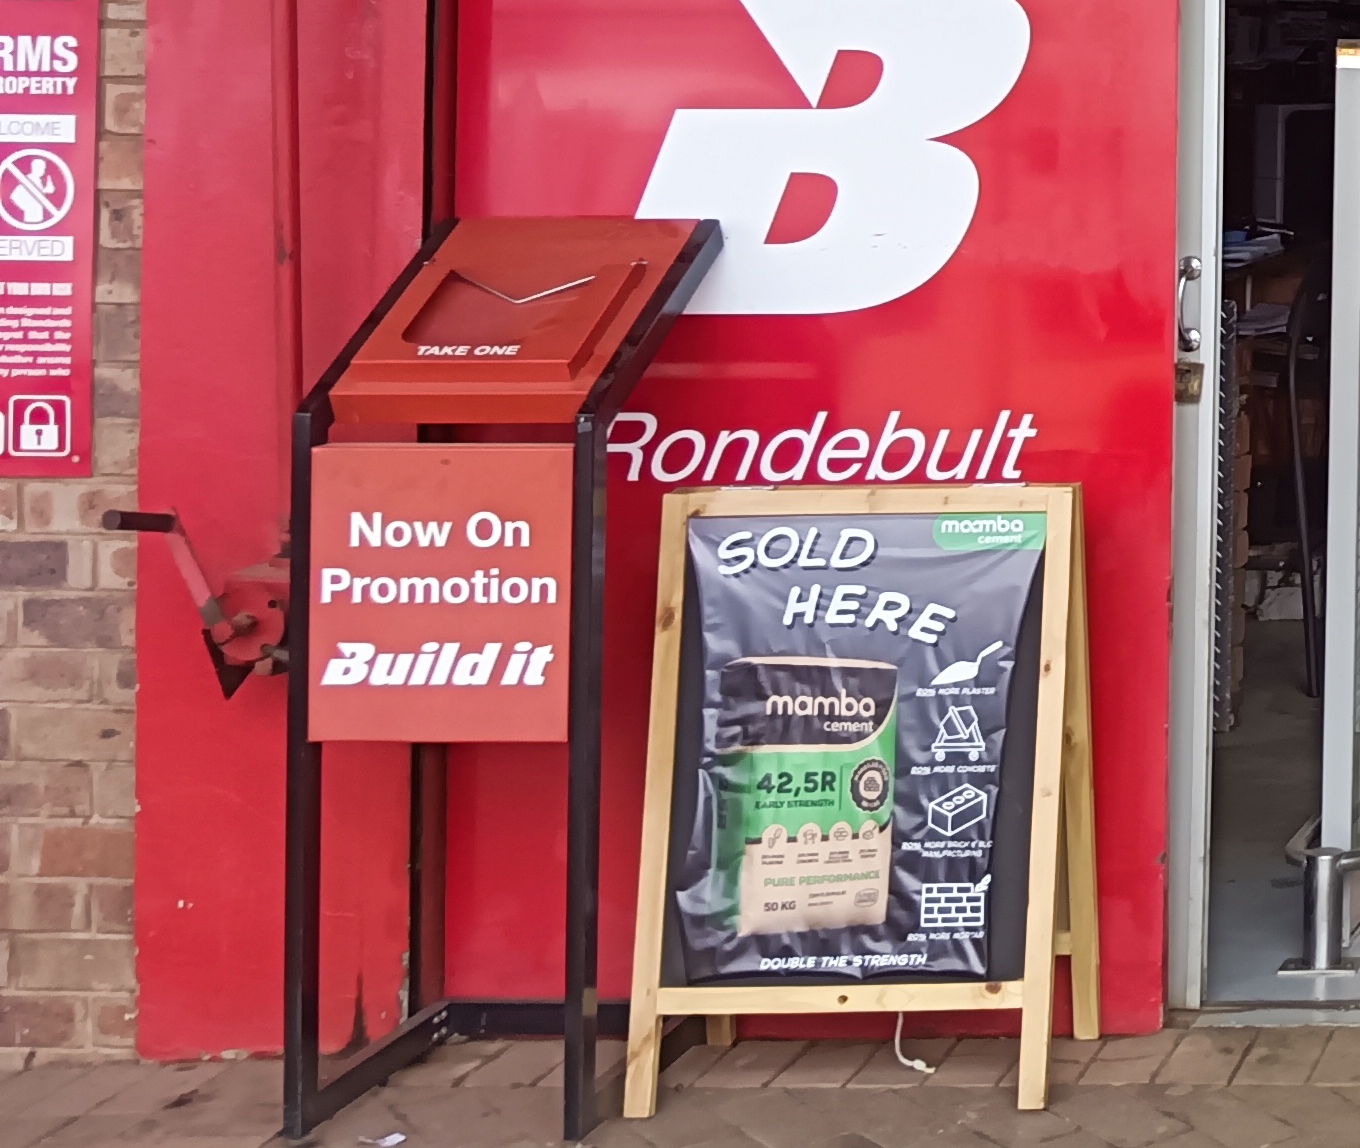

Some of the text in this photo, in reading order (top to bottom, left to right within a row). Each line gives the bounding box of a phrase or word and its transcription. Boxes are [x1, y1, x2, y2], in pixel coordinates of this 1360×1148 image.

[416, 345, 521, 356] TAKE ONE
[606, 409, 1038, 483] Rondebult
[349, 510, 530, 548] Now On
[976, 533, 1023, 545] cement
[717, 525, 880, 579] SOLD
[320, 567, 558, 604] Promotion
[781, 583, 958, 645] HERE
[319, 641, 554, 687] Build it
[765, 688, 876, 718] mamba
[823, 719, 875, 733] cement
[756, 770, 837, 798] 42,5R
[763, 870, 880, 887] PURE PERFORMANCE
[763, 901, 796, 912] 50 KG
[760, 953, 928, 970] DOUBLE THE STRENGTH
